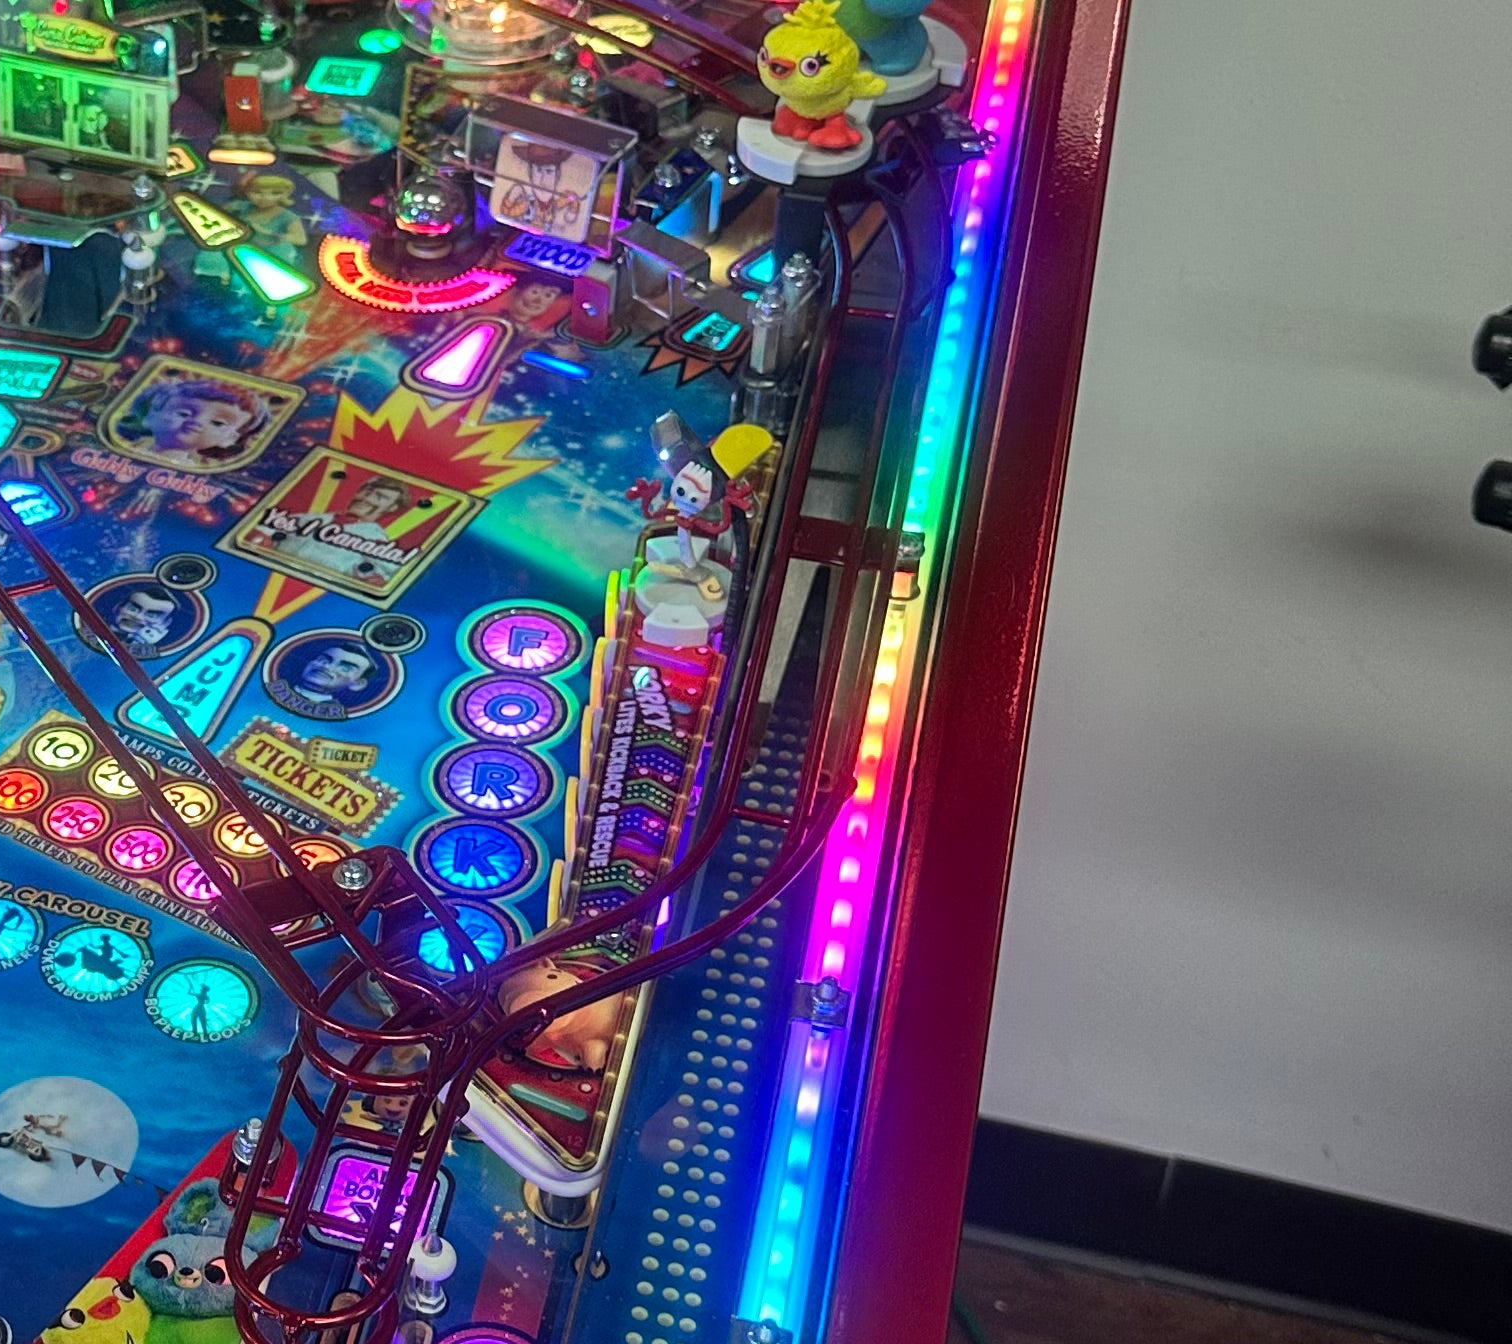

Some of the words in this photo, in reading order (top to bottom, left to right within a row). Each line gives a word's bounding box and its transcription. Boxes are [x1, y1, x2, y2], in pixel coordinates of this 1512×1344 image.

[71, 448, 146, 484] Gabby
[146, 468, 224, 504] Gabby
[264, 507, 299, 535] Yes
[318, 521, 422, 565] Canada!
[508, 626, 550, 658] F
[268, 679, 348, 720] DANGER
[613, 700, 636, 735] LITES
[43, 736, 80, 759] 10
[321, 745, 369, 764] TICKET
[246, 737, 369, 818] TICKETS
[470, 761, 520, 801] R
[246, 789, 320, 830] TICKETS
[51, 805, 101, 837] 250
[114, 836, 164, 867] 500
[453, 837, 502, 876] K
[588, 815, 618, 869] RESCUE
[15, 826, 74, 865] TICKETS
[75, 856, 95, 875] TO
[96, 867, 135, 897] PLAY
[137, 888, 207, 934] CARNIVAL
[14, 886, 153, 938] CAROUSEL
[45, 939, 60, 976] DUKE
[117, 956, 156, 999] JUMPS
[47, 973, 115, 1003] CABOOM
[155, 1015, 194, 1042] PEEP
[199, 1015, 253, 1043] LOOPS
